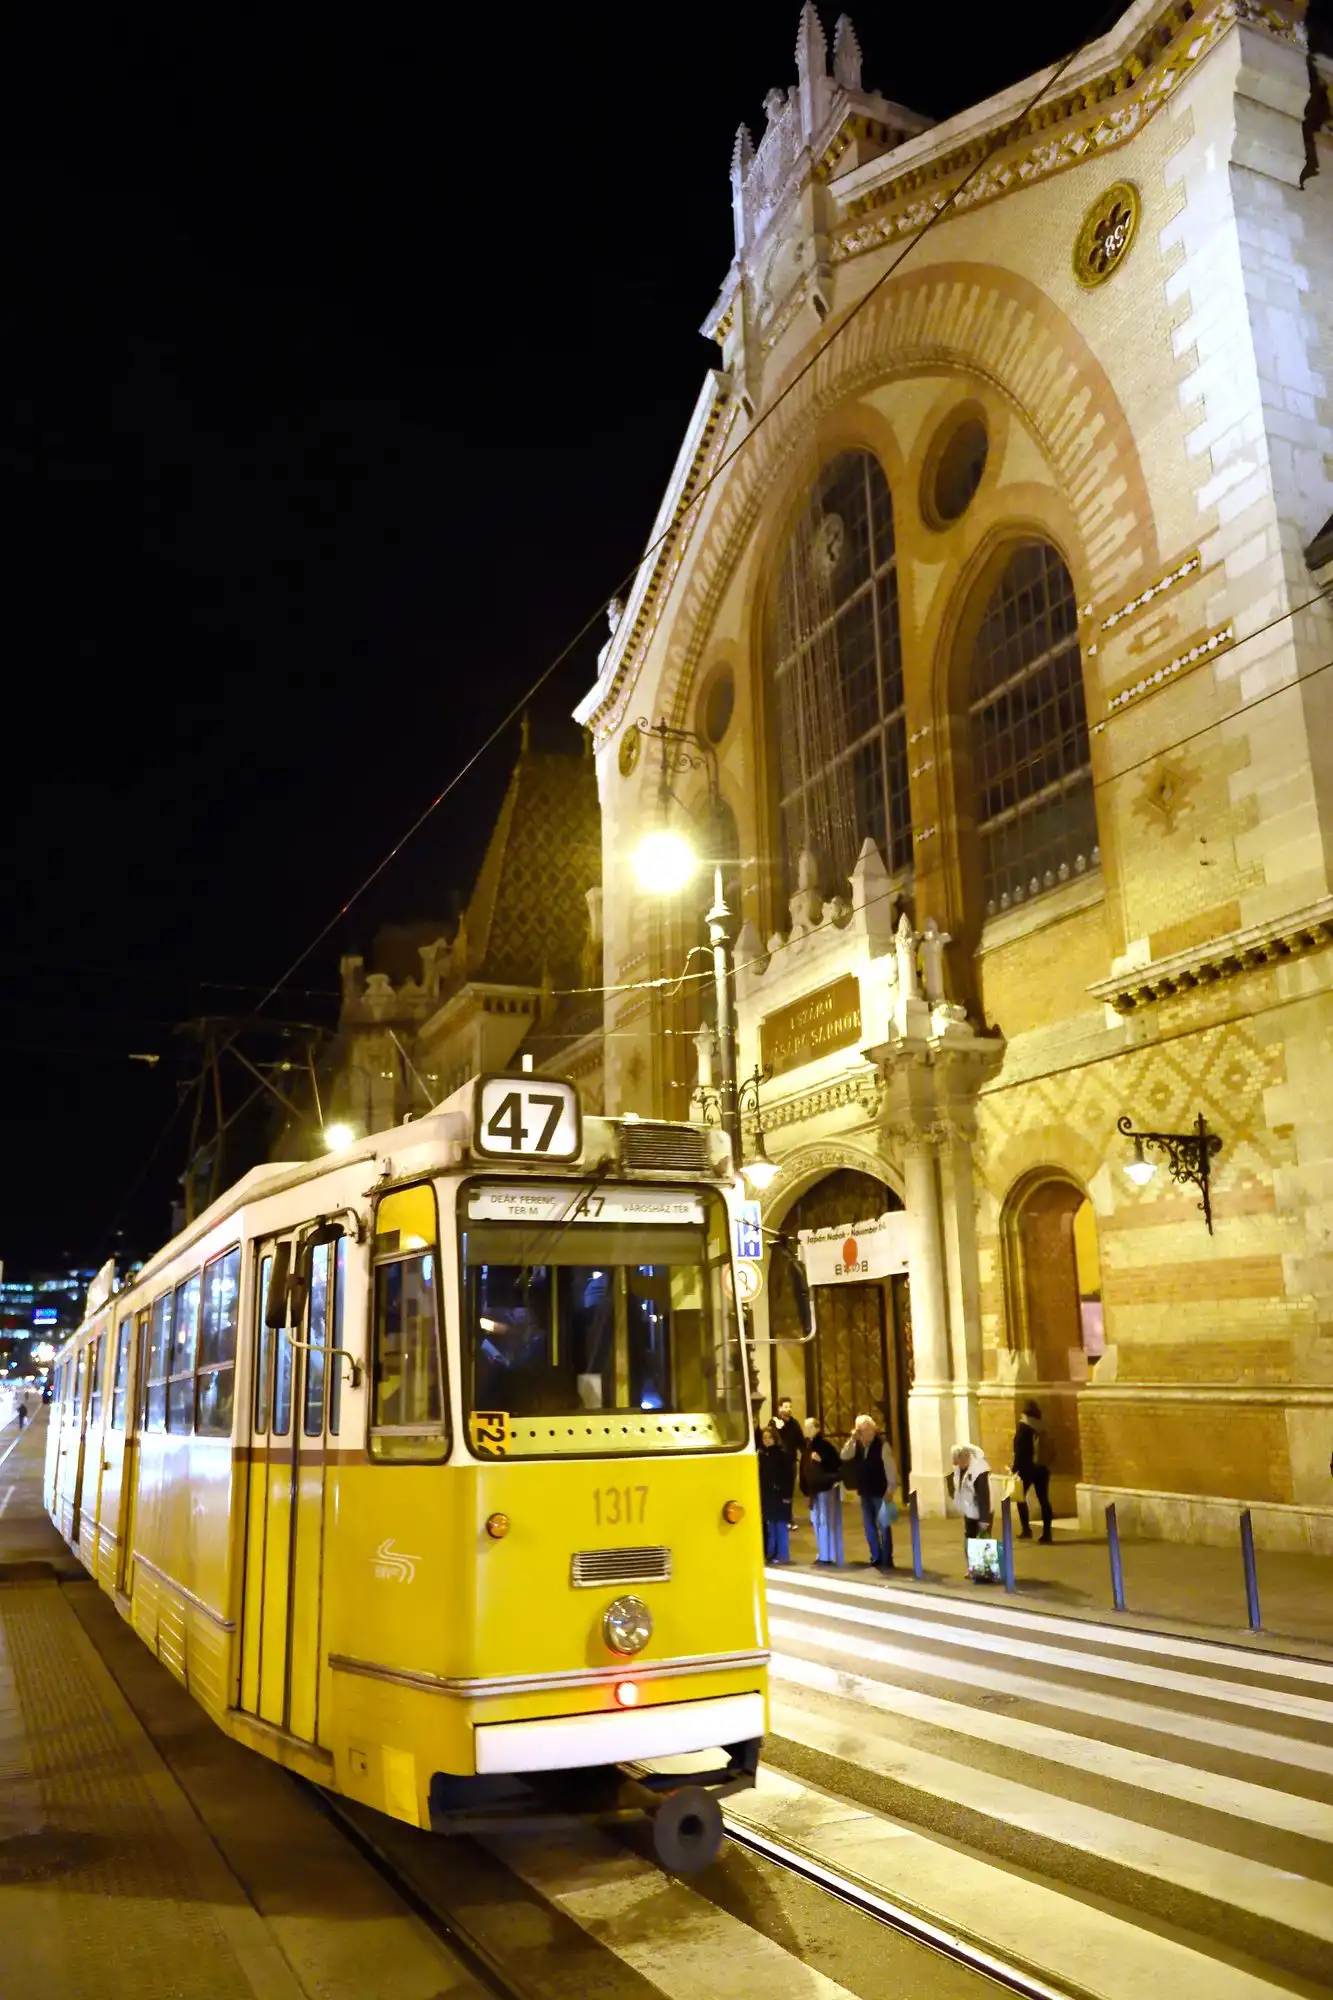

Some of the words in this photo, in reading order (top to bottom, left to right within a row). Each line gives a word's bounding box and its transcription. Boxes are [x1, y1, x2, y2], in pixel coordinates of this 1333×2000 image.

[487, 1092, 565, 1152] 47
[575, 1196, 606, 1217] 47
[593, 1486, 649, 1526] 1317
